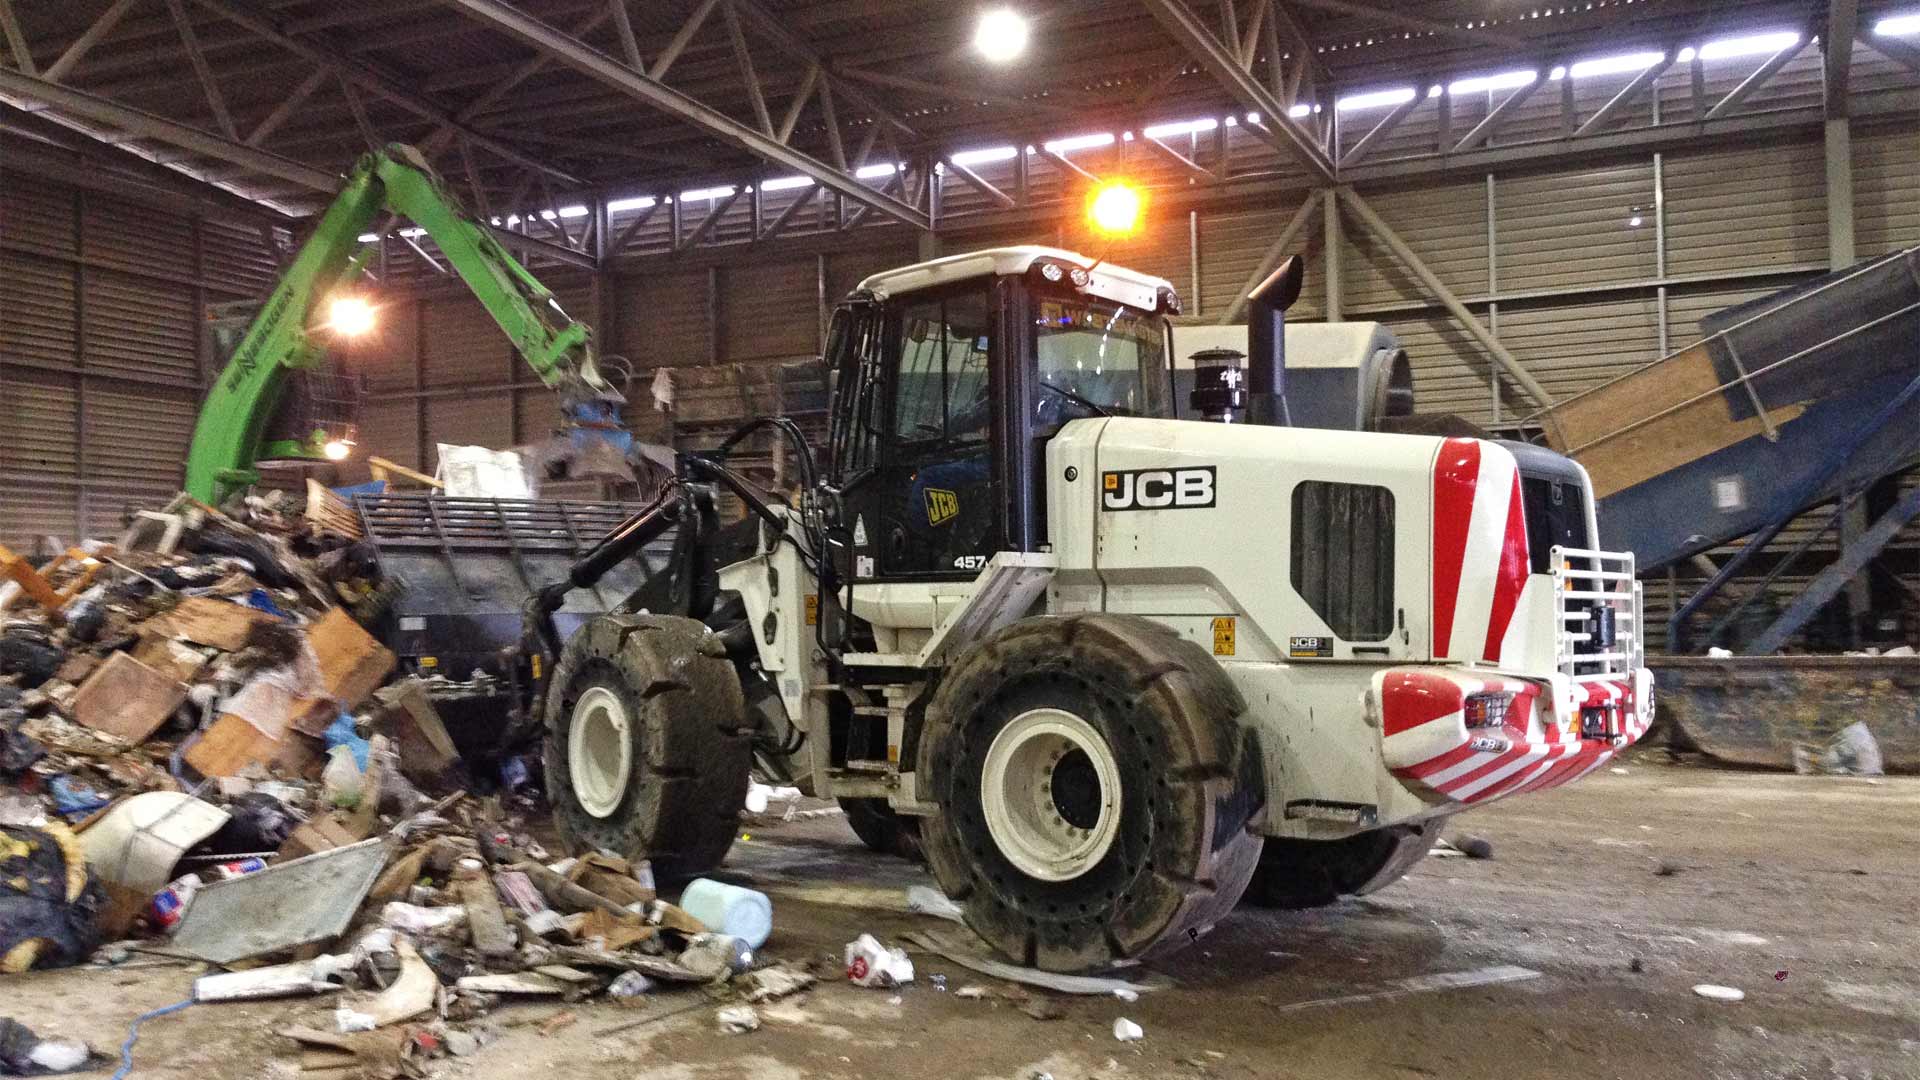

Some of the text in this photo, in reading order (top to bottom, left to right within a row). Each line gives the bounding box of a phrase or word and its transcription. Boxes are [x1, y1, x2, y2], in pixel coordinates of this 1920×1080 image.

[1104, 469, 1214, 509] JCB
[929, 491, 956, 522] JCB
[954, 555, 986, 569] 457
[1291, 637, 1318, 647] JCB
[1471, 737, 1496, 749] JCB
